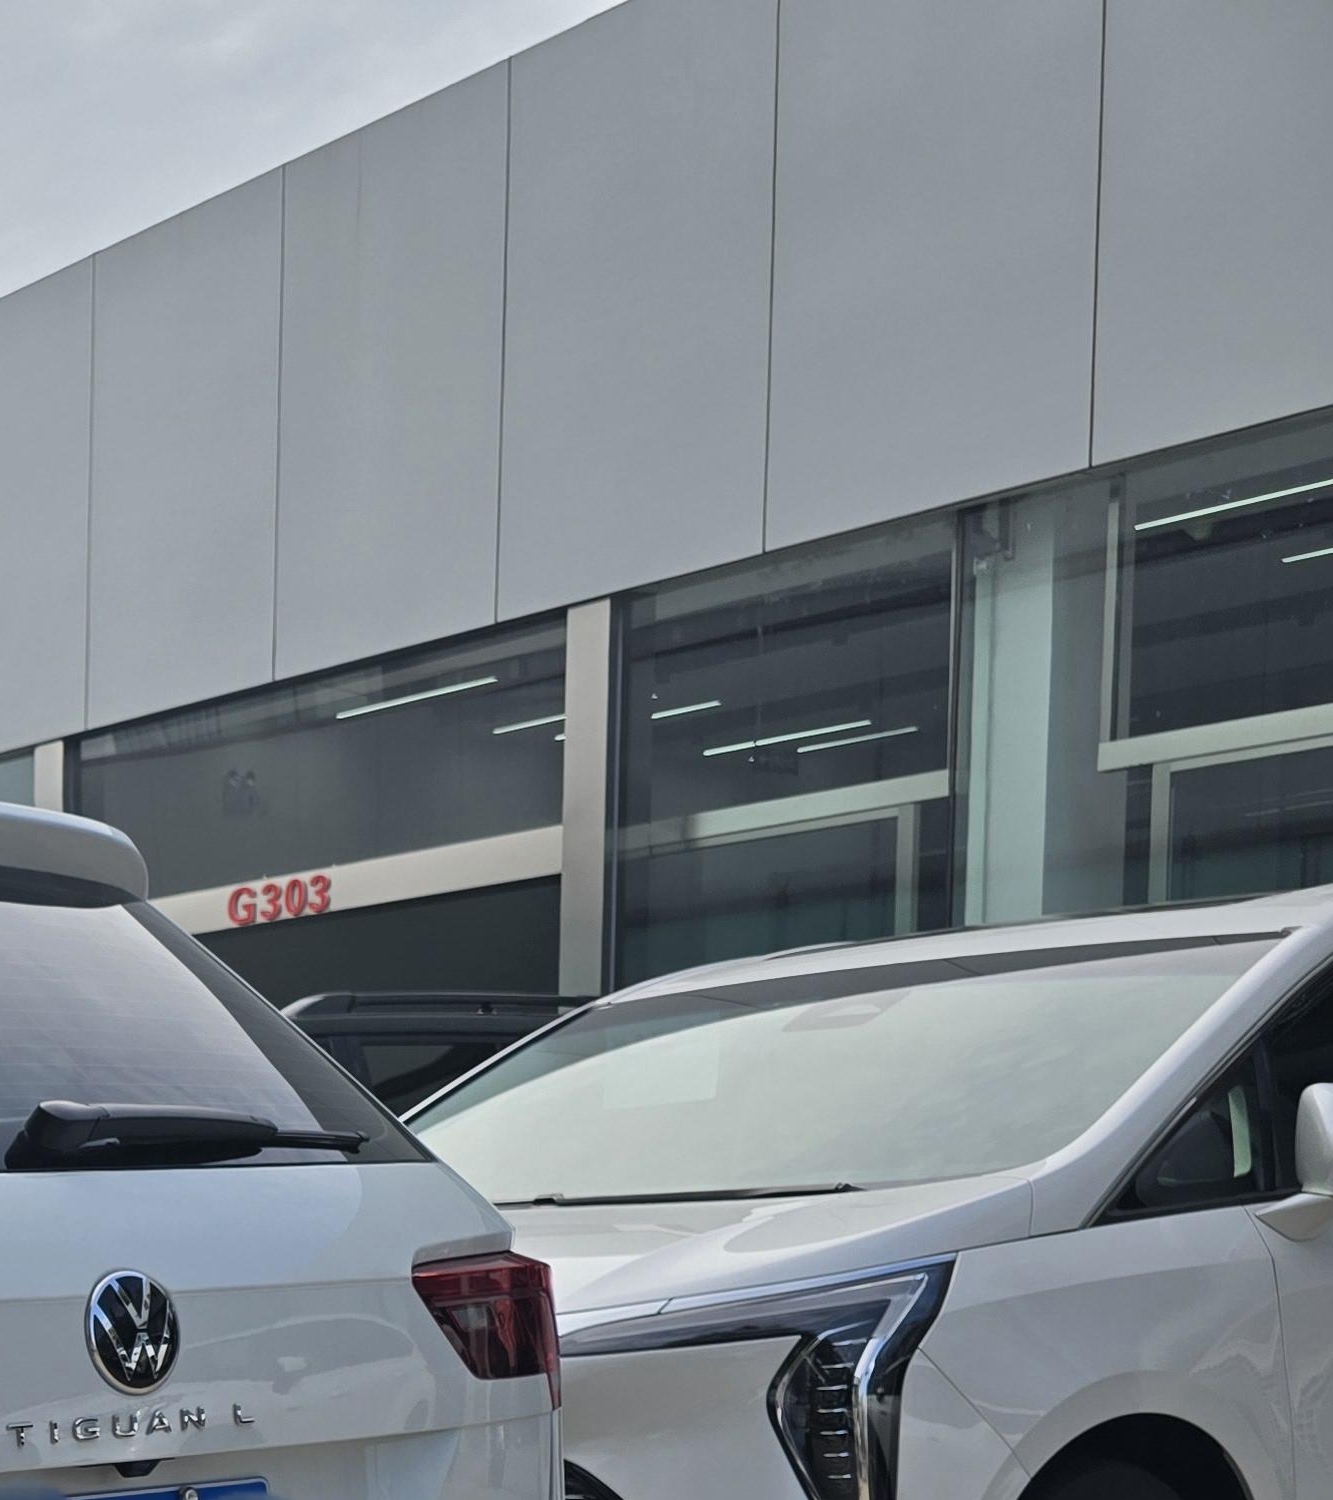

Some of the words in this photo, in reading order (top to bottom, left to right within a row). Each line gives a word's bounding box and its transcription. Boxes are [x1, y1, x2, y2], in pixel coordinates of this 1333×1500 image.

[227, 874, 332, 927] G303
[88, 1271, 177, 1392] VW
[6, 1406, 206, 1447] TIGUAN
[232, 1403, 256, 1426] L
